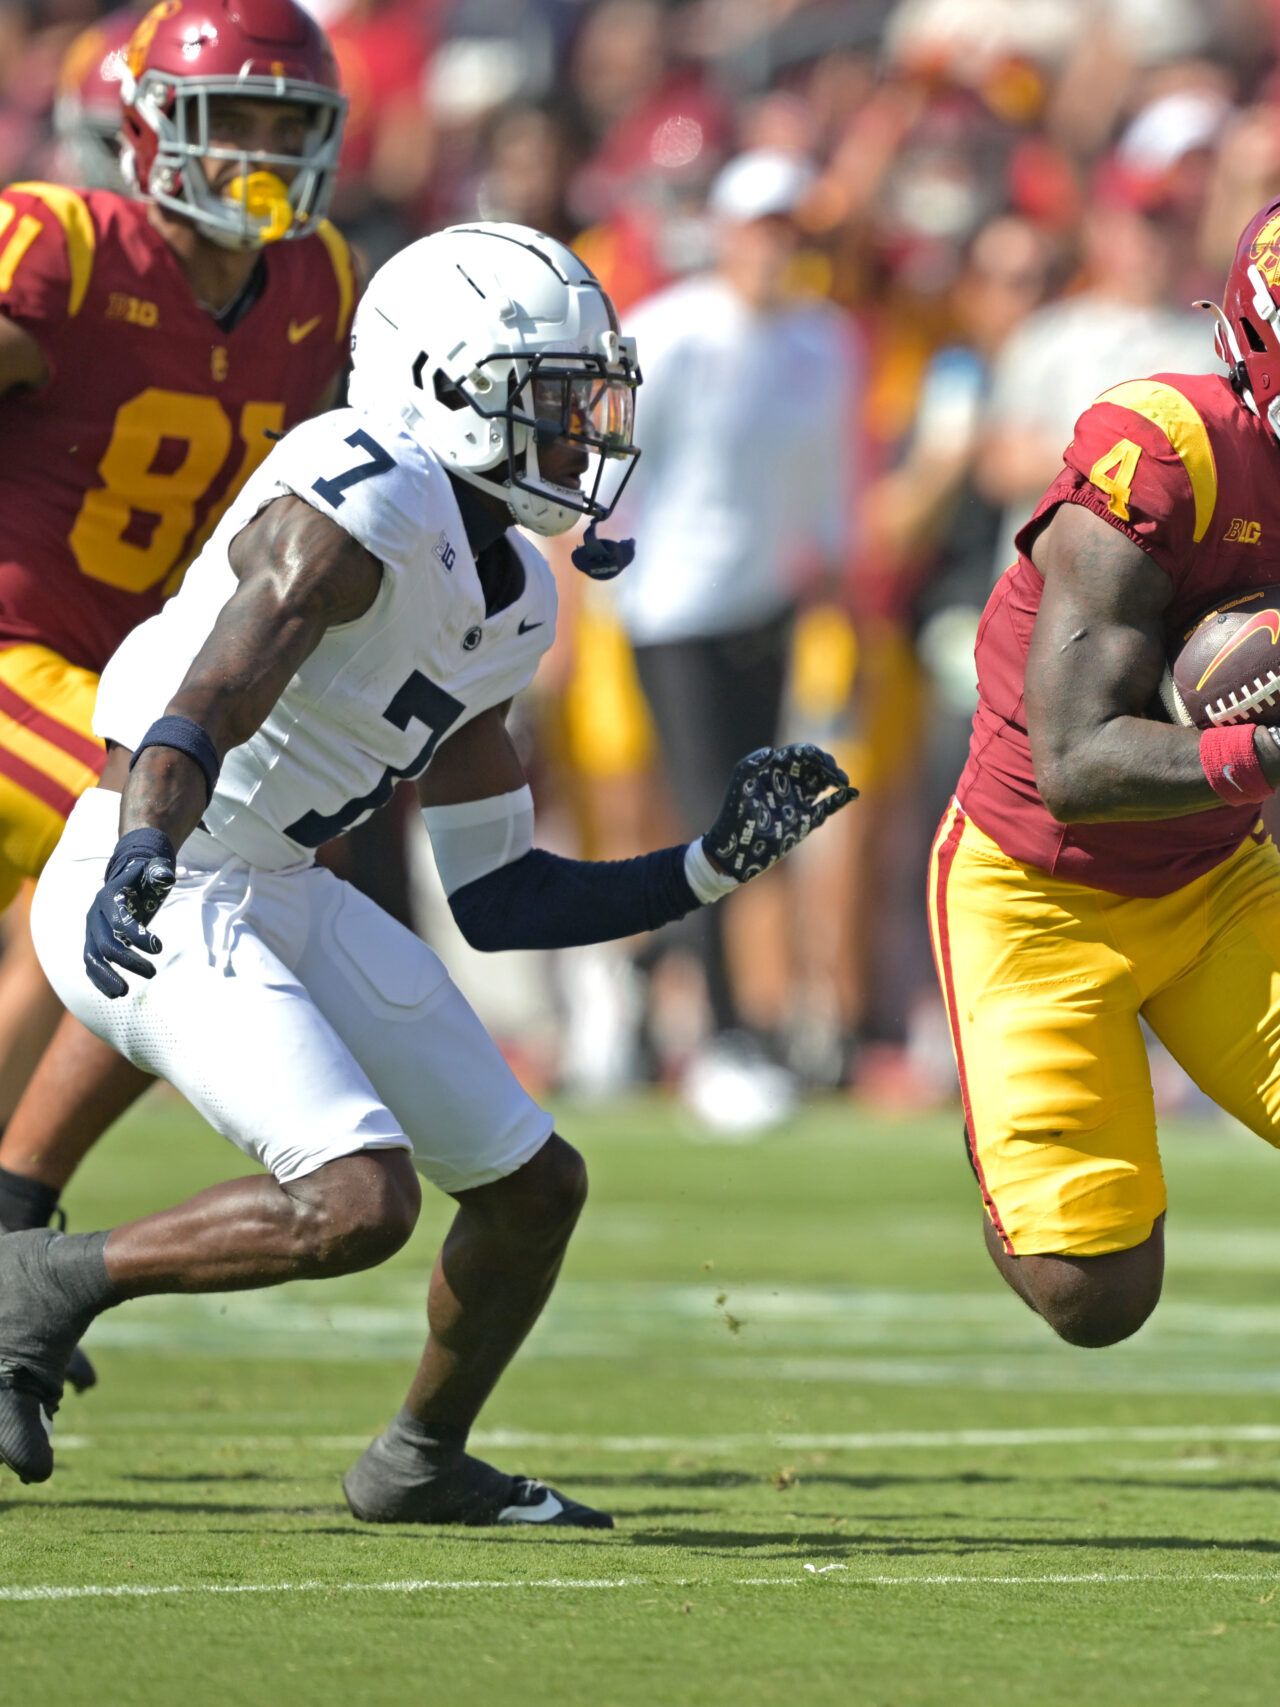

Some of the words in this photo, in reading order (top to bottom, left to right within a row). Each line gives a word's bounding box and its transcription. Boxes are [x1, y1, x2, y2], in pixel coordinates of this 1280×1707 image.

[311, 428, 397, 509] 7
[1089, 438, 1143, 522] 4
[282, 669, 467, 849] 7
